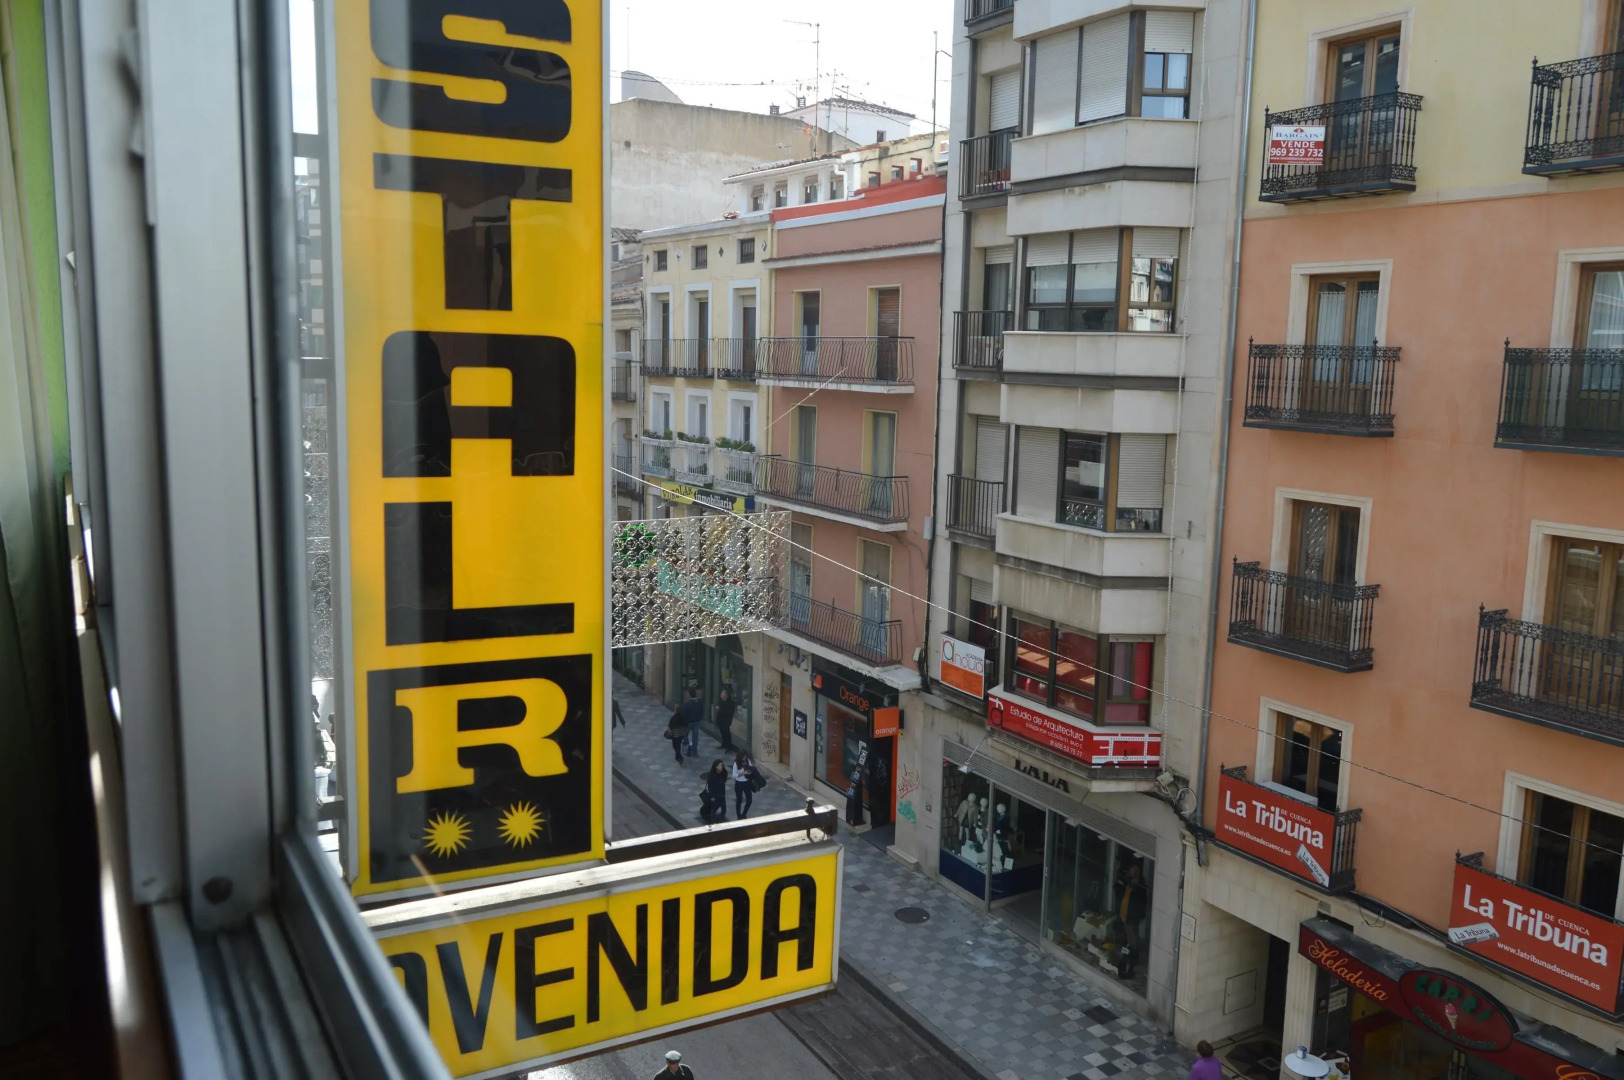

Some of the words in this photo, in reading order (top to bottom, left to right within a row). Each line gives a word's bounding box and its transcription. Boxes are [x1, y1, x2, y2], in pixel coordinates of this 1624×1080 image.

[1270, 147, 1287, 156] 969
[1289, 148, 1305, 157] 239
[1307, 149, 1323, 157] 732
[695, 491, 733, 510] inmobiliaria
[840, 685, 870, 711] Orange
[395, 677, 569, 794] R
[875, 726, 897, 735] orange
[1010, 705, 1032, 721] Estudio
[1033, 715, 1043, 725] de
[1043, 718, 1084, 742] Arquitectura
[1014, 759, 1071, 793] LALA
[1225, 790, 1247, 818] La
[1252, 800, 1324, 849] Tribuna
[1289, 812, 1312, 825] CUENCA
[1224, 823, 1292, 856] www.latribunadecuenca.es
[1309, 860, 1326, 883] Tribuna
[1454, 931, 1466, 940] La
[1464, 928, 1491, 937] Tribuna
[1463, 884, 1494, 919] La
[1502, 899, 1608, 967] Tribuna
[1544, 912, 1555, 922] DE
[1558, 918, 1590, 936] CUENCA
[1308, 939, 1389, 1002] Heladería
[1497, 941, 1601, 991] www.latribunadecuenca.es
